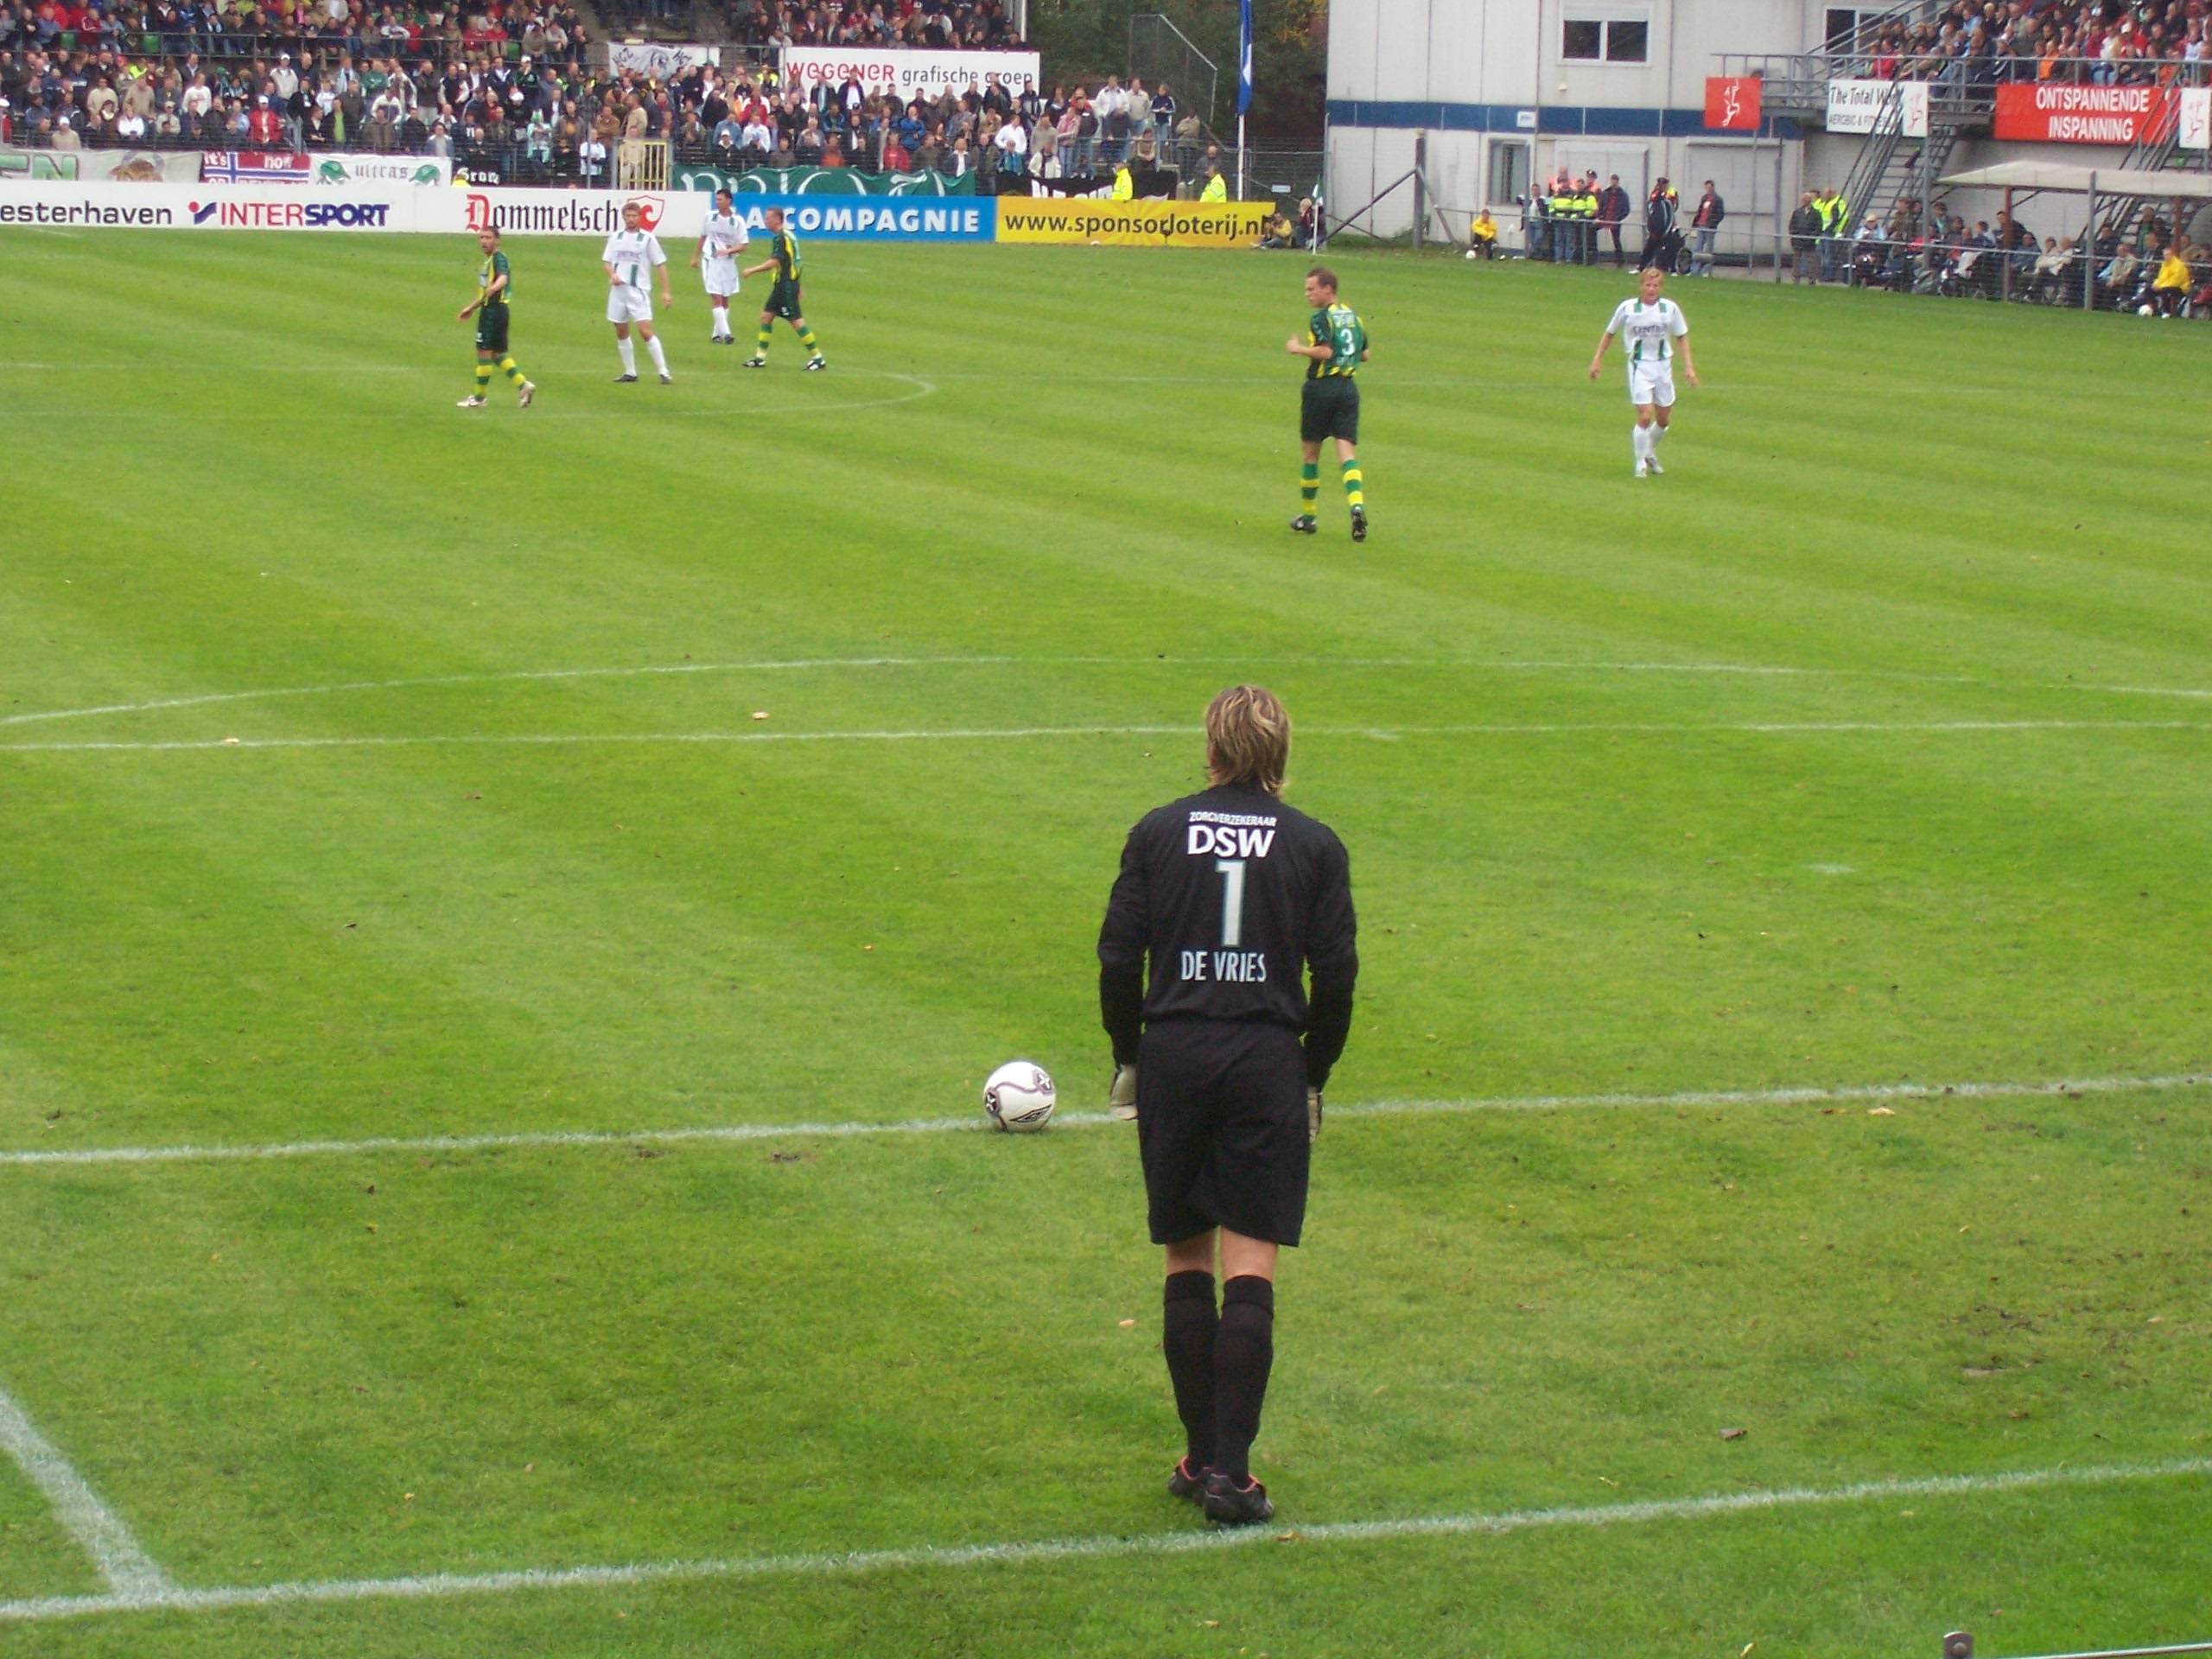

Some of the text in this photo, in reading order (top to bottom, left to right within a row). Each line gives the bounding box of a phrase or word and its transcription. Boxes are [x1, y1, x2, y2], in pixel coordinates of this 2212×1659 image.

[902, 66, 979, 86] grafische
[1830, 87, 1848, 105] The
[1850, 87, 1875, 105] Total
[2036, 86, 2151, 112] ONTSPANNENDE
[2048, 116, 2134, 141] INSPANNING
[220, 201, 389, 227] INTERSPORT
[465, 194, 619, 233] Dommelsch
[1005, 213, 1266, 241] www.sponsorloterij.nl
[1340, 328, 1357, 356] 3
[1188, 825, 1275, 857] DSW
[1216, 860, 1247, 947] 1
[1181, 951, 1268, 982] DE VRIES
